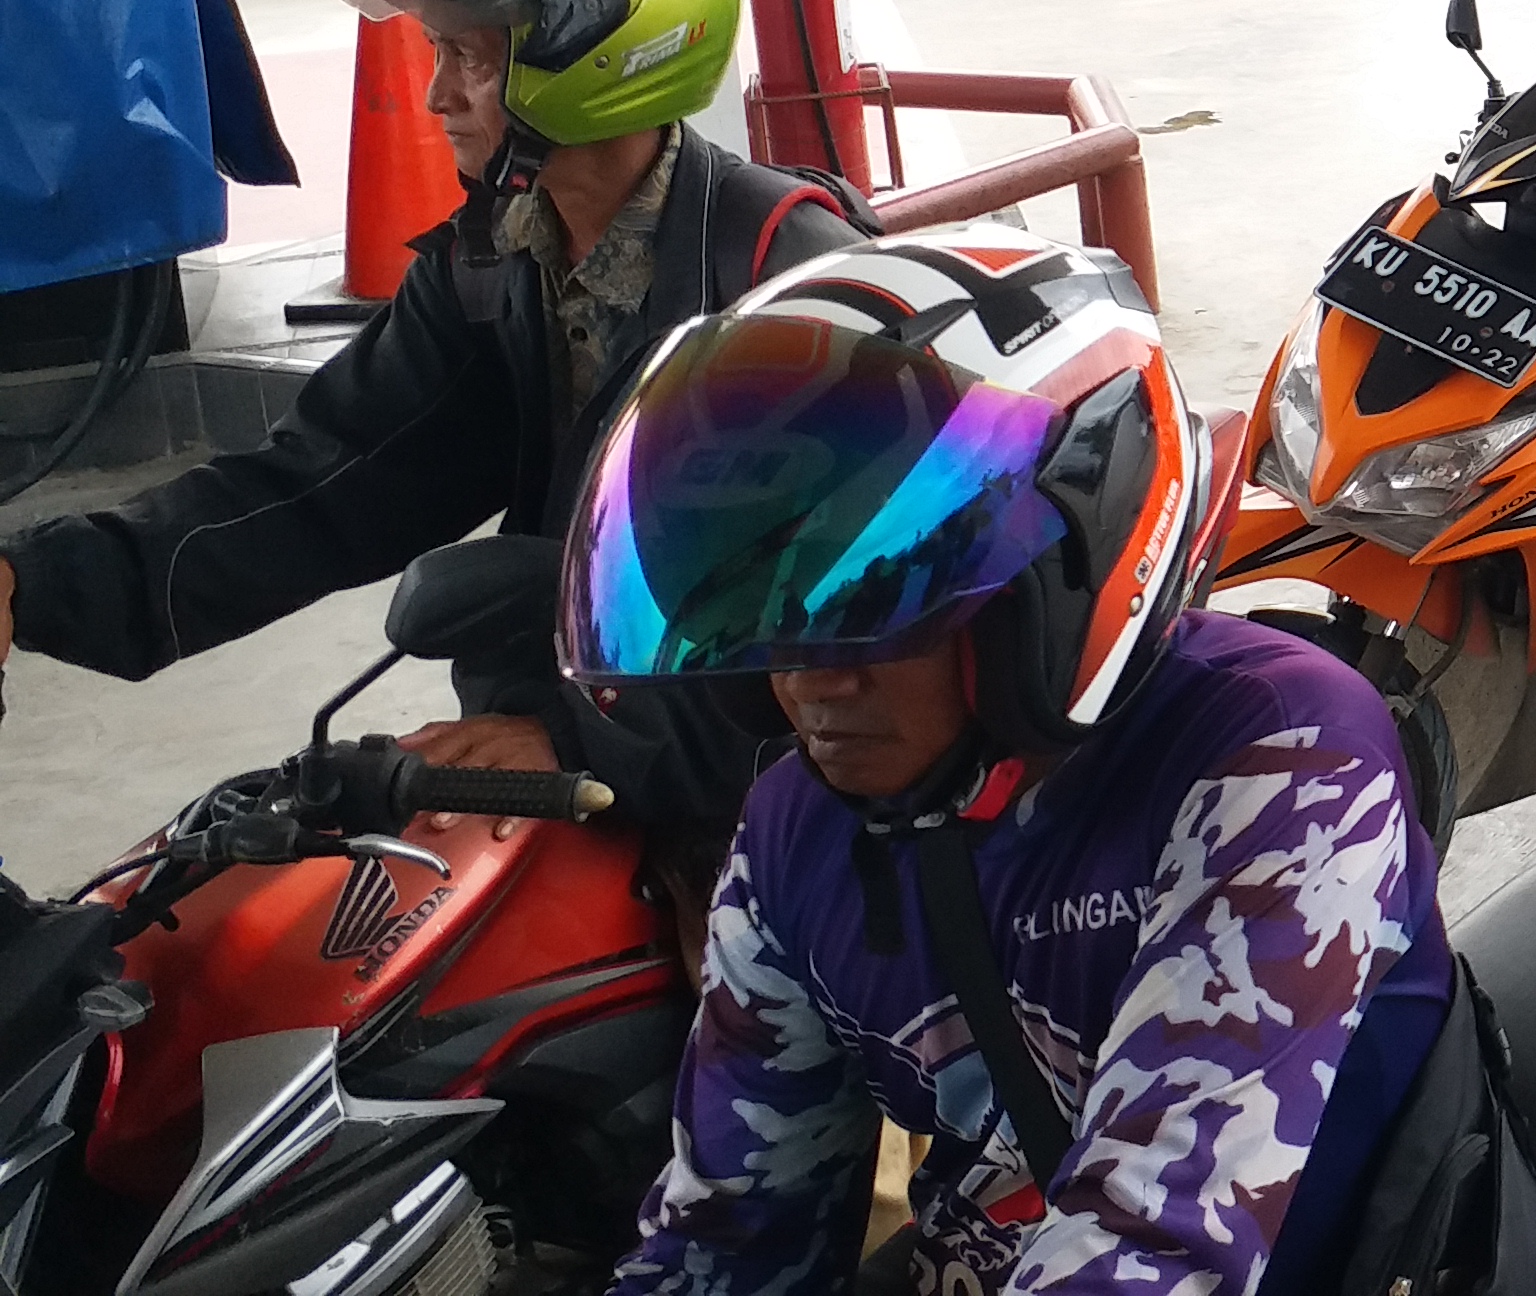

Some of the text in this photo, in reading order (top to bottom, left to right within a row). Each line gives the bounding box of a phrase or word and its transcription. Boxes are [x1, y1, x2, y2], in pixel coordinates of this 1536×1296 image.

[1352, 236, 1410, 277] KU
[1414, 264, 1498, 319] 5510
[354, 885, 455, 984] HONDA
